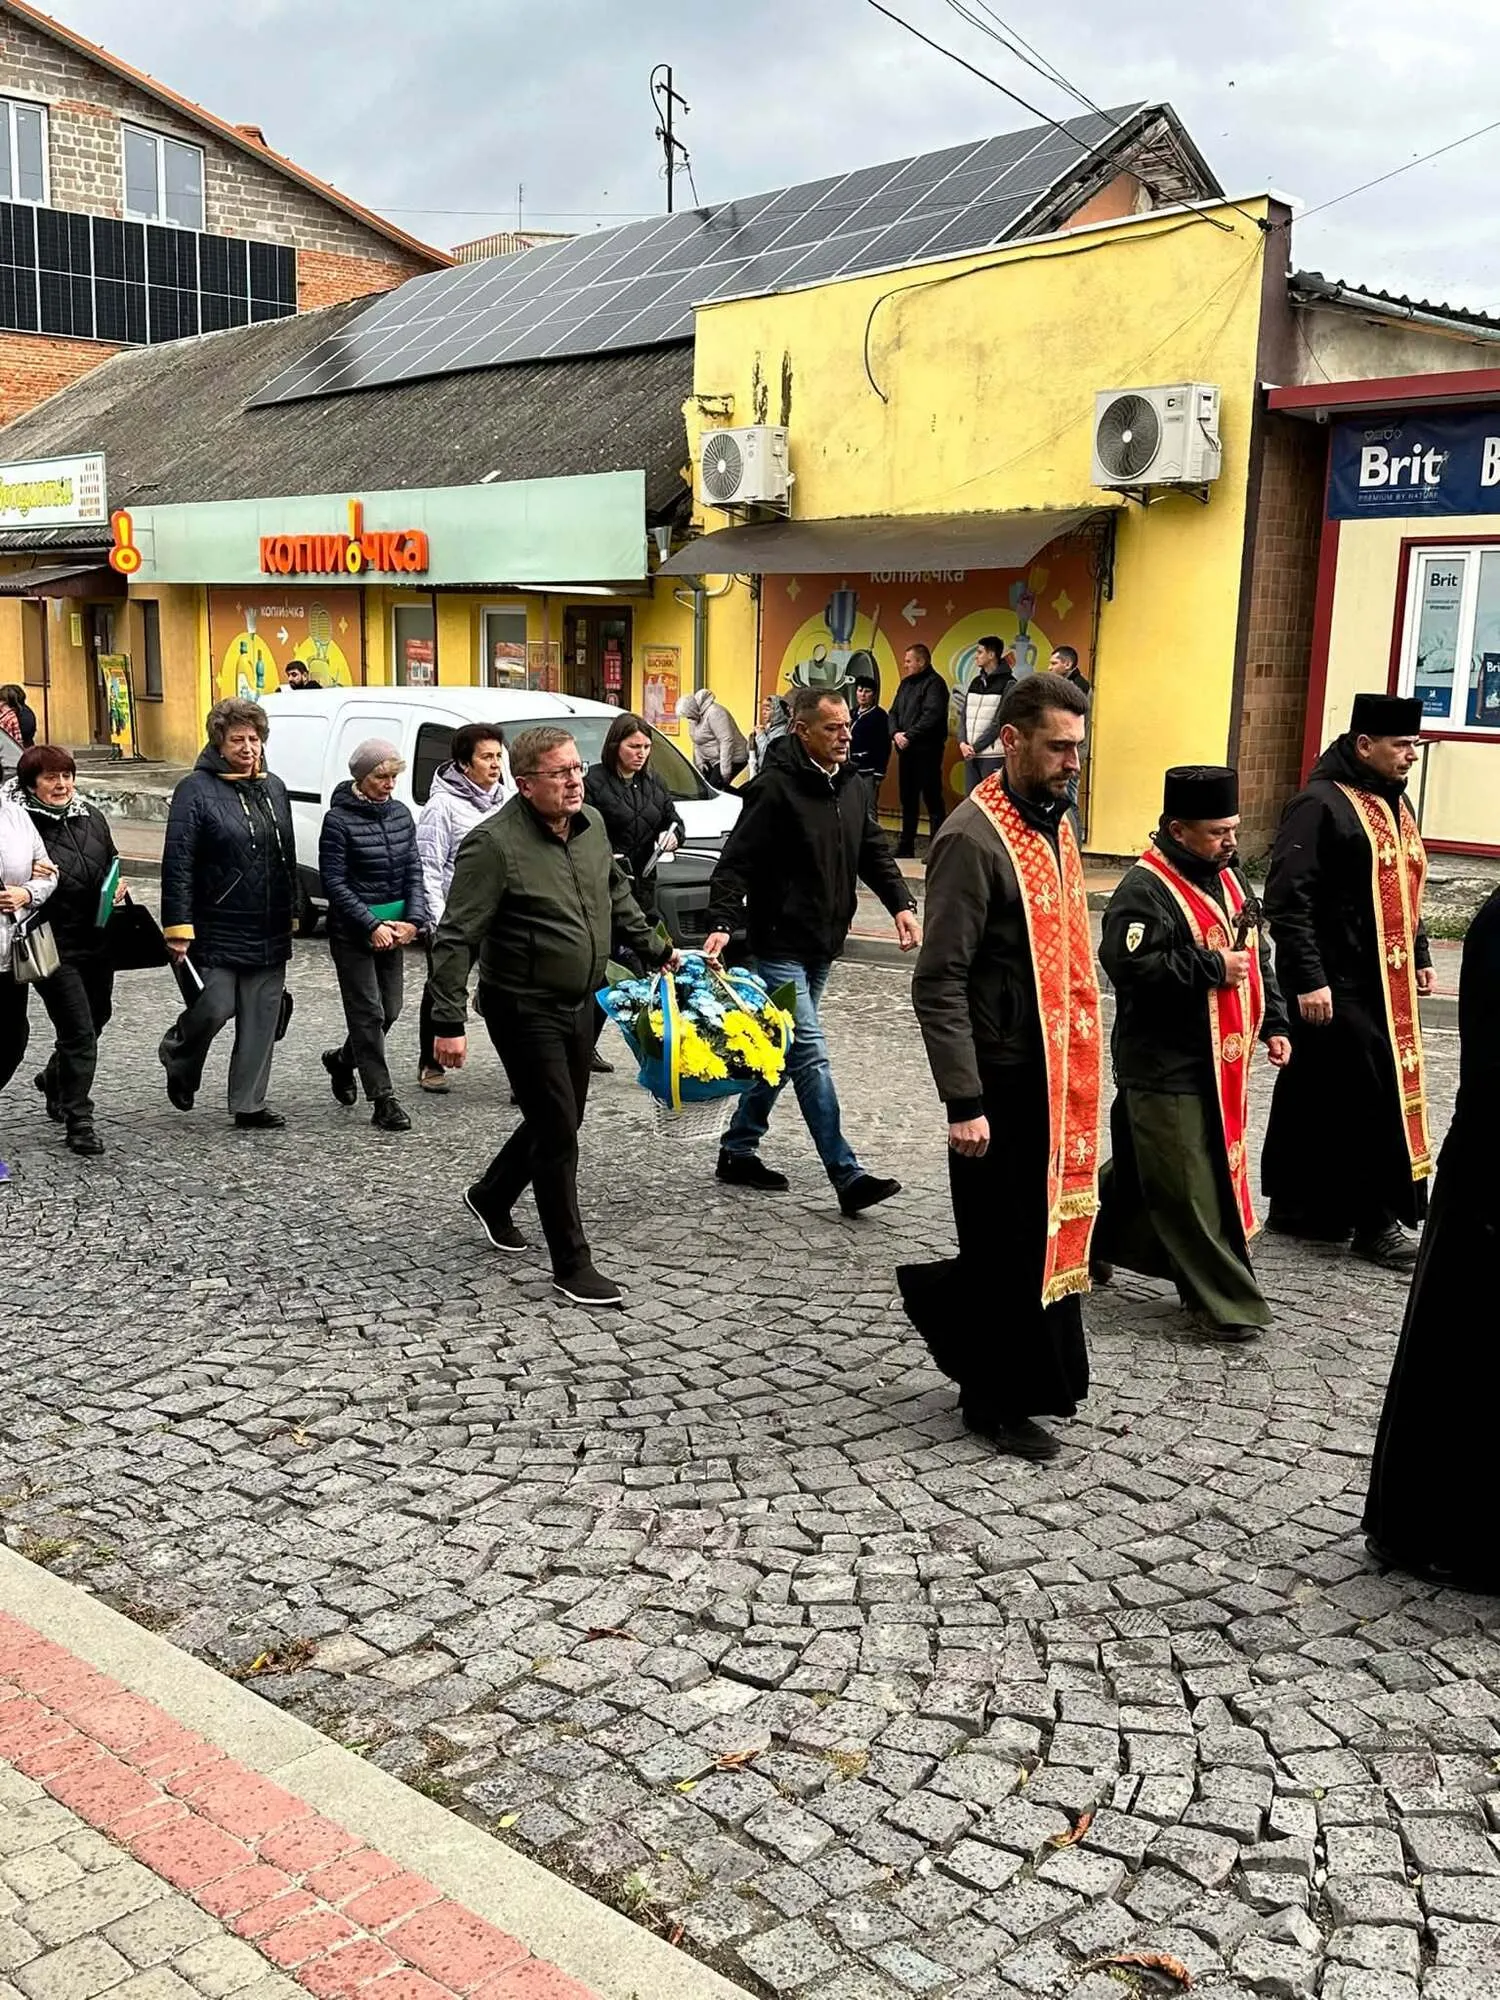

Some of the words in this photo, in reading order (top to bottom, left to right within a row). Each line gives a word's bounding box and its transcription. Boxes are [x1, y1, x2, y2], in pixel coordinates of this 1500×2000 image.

[1359, 443, 1443, 487] Brit
[1358, 494, 1393, 502] PREMIUM
[1395, 493, 1405, 501] BY
[1430, 572, 1459, 587] Brit
